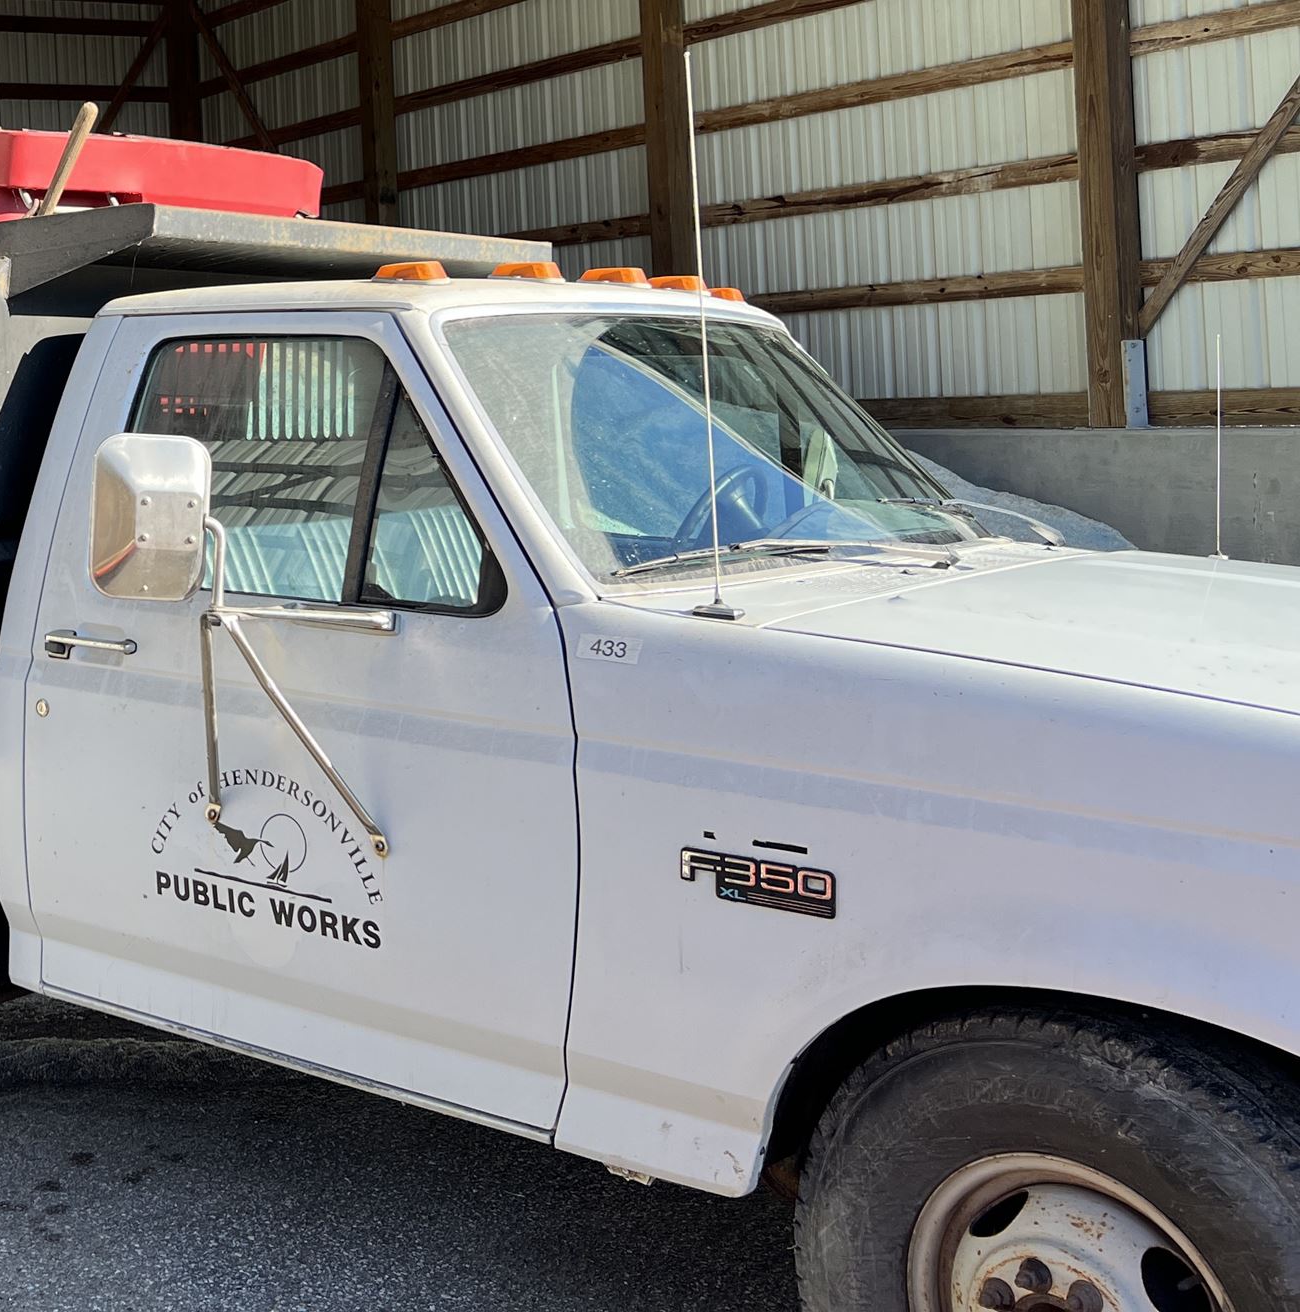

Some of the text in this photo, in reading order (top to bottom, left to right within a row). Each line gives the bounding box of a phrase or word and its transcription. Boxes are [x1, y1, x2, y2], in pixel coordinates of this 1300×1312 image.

[589, 638, 628, 659] 433
[151, 768, 384, 905] CITY of HENDERSONVILLE
[155, 870, 382, 949] PUBLIC WORKS
[719, 886, 747, 901] XL
